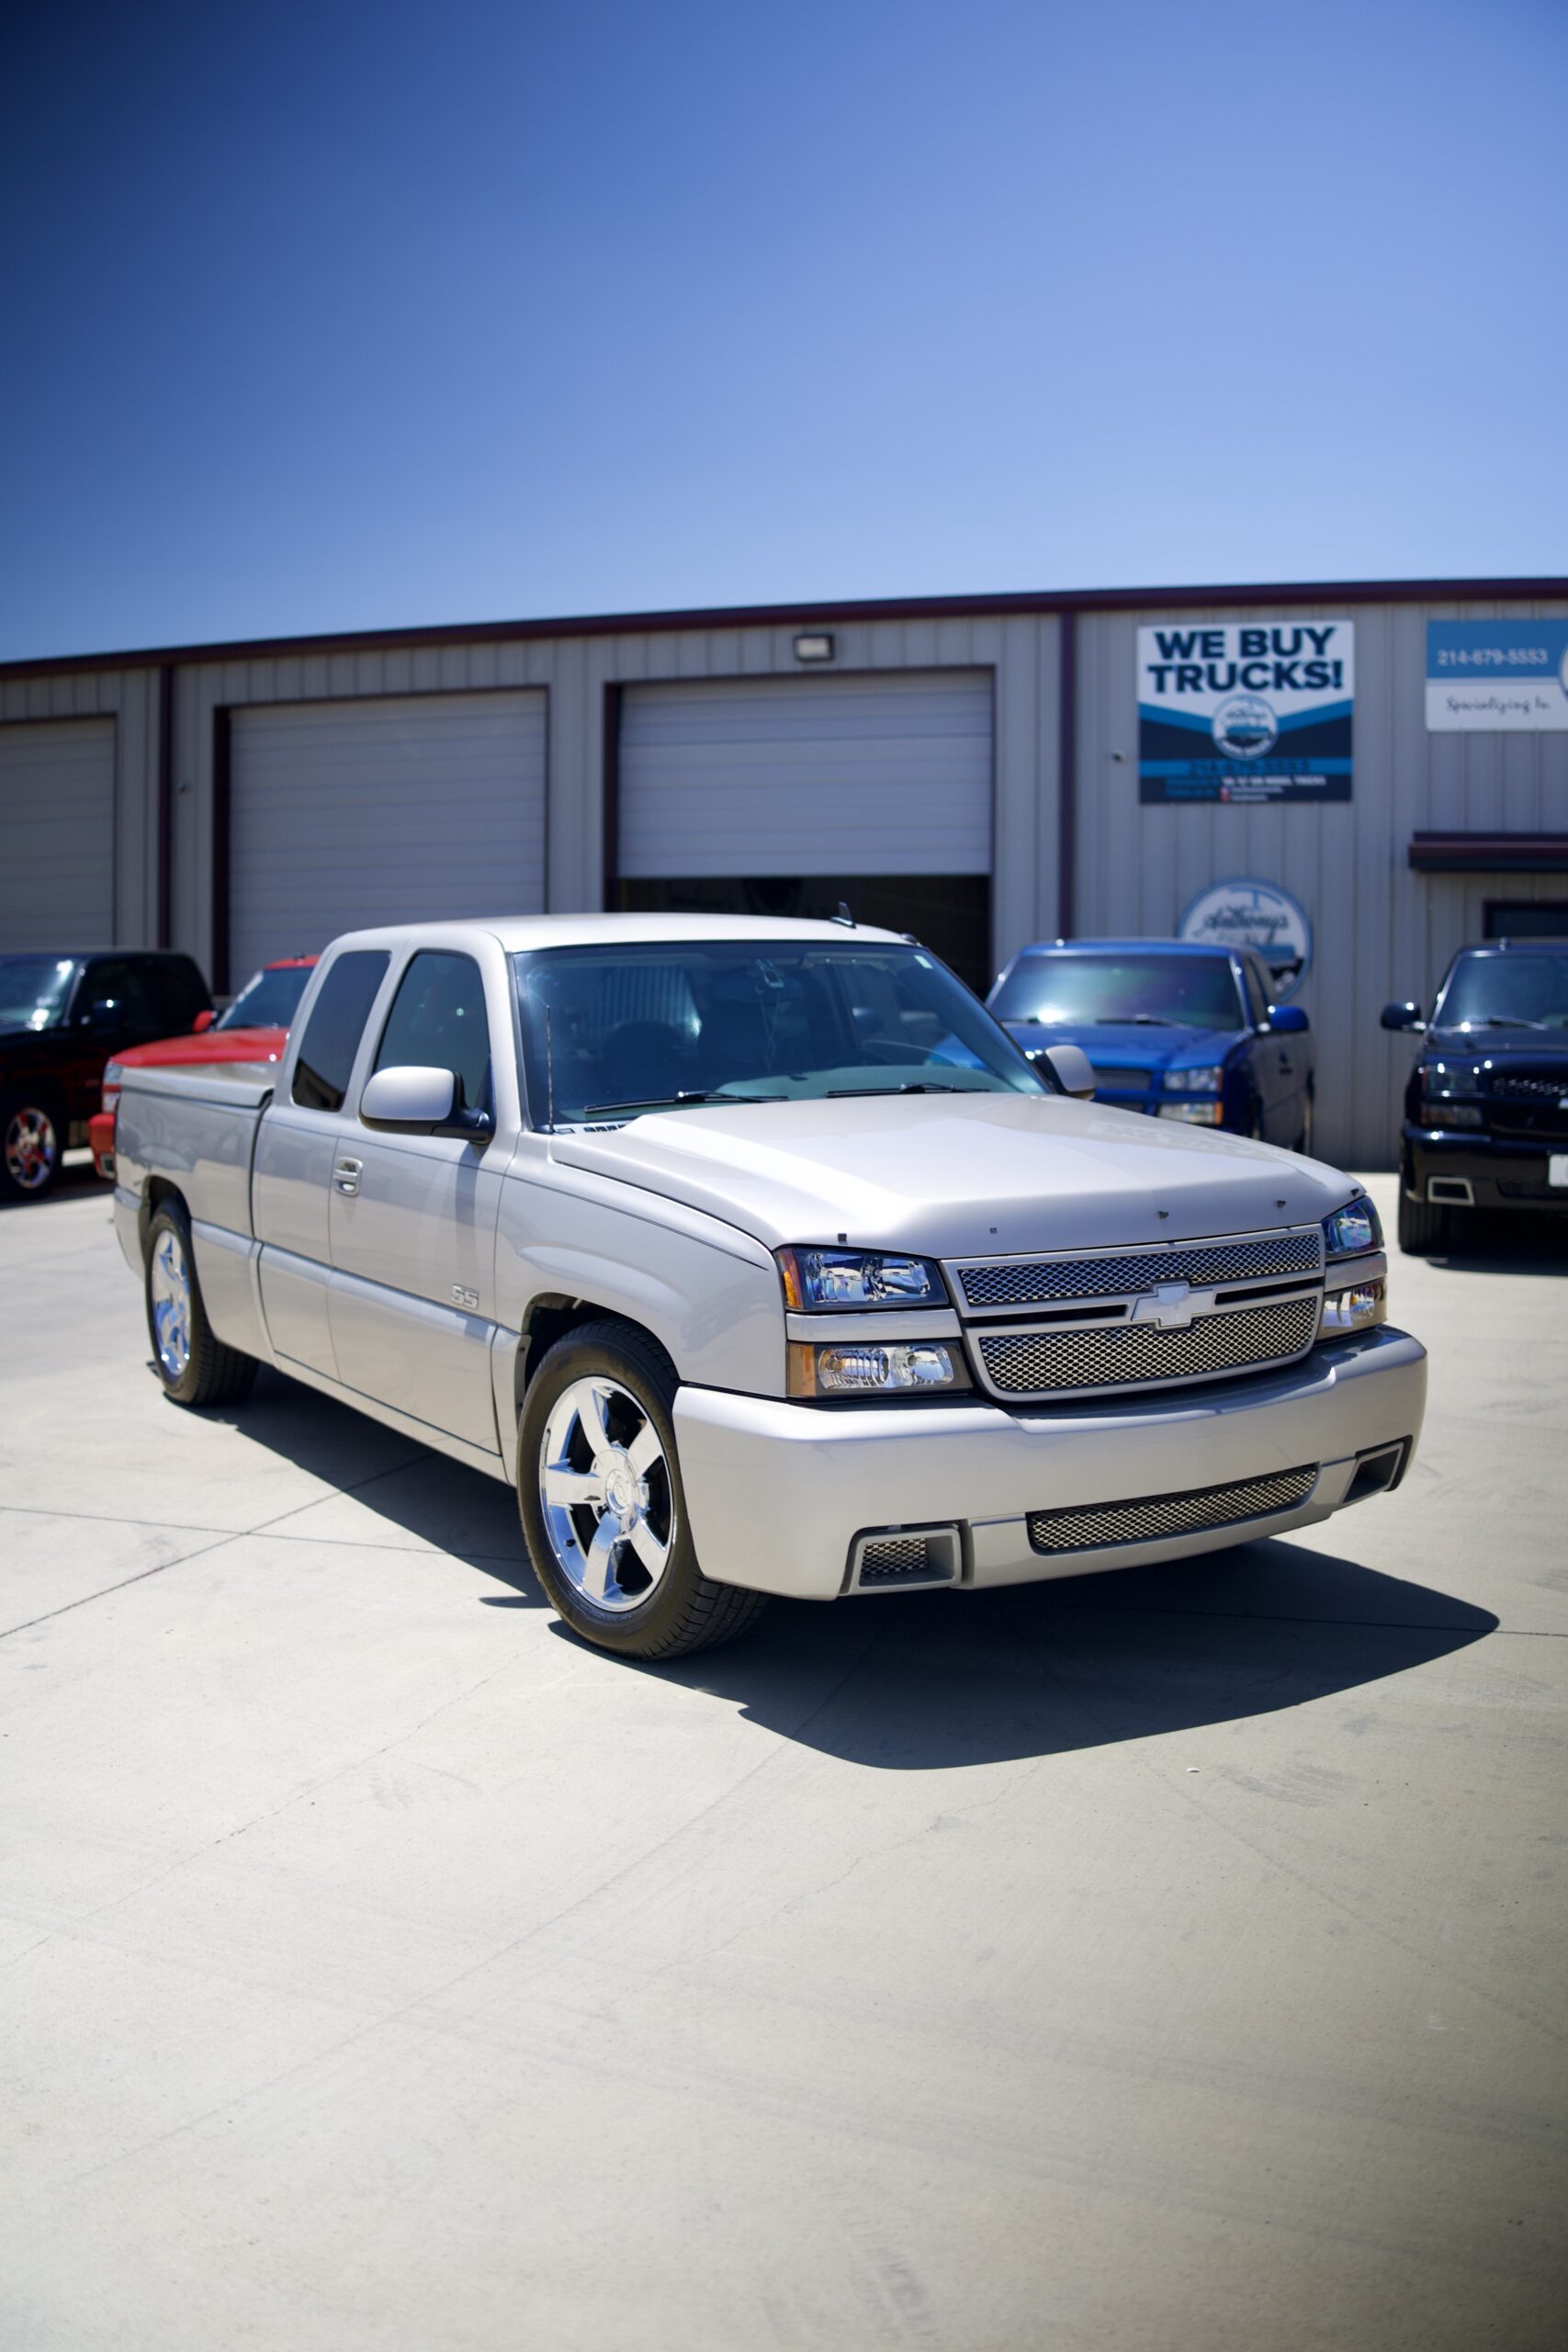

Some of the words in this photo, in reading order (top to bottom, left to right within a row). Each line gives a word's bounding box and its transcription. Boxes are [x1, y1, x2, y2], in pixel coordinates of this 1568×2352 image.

[1155, 630, 1225, 660] WE
[1239, 627, 1336, 658] BUY
[1437, 648, 1549, 666] 214-679-5553
[1147, 660, 1344, 694] TRUCKS!
[451, 1284, 479, 1310] SS
